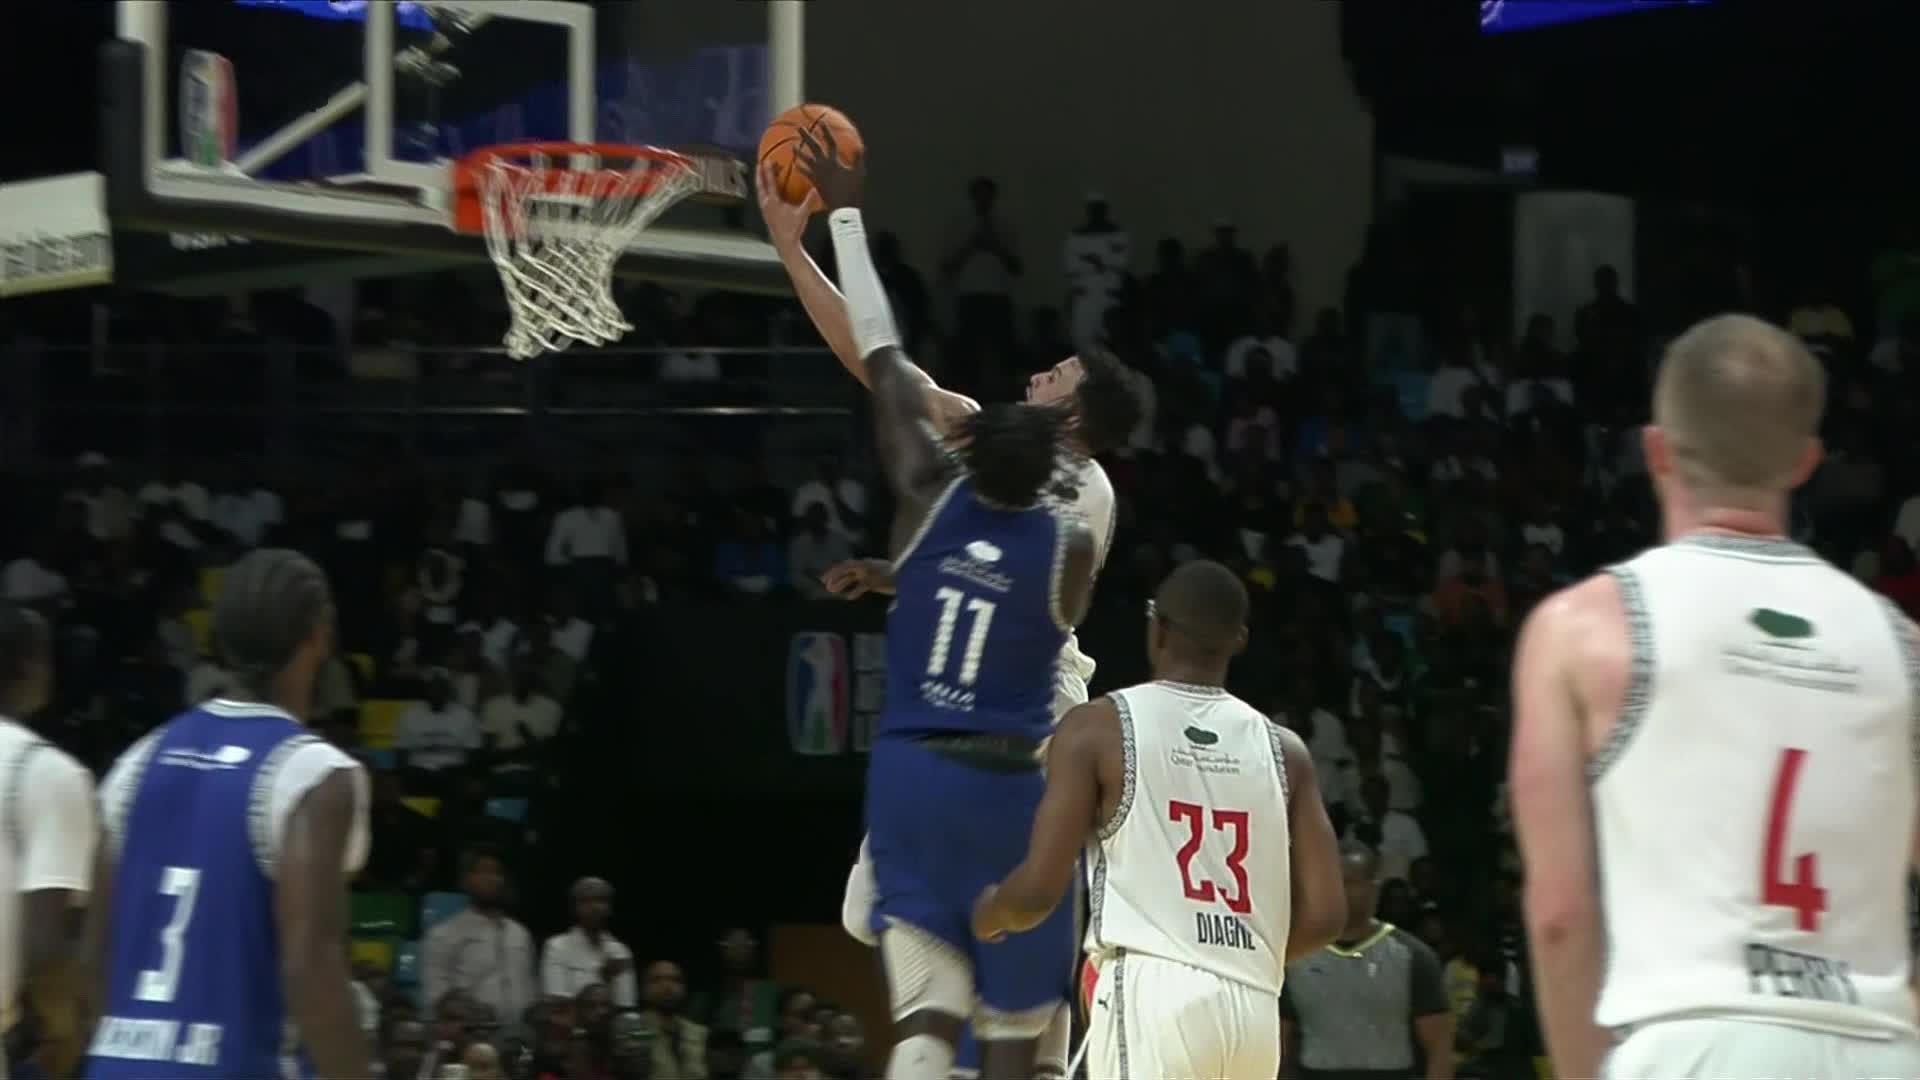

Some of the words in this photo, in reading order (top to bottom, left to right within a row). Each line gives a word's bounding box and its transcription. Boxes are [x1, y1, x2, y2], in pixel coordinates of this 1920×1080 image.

[926, 585, 997, 687] 11
[1168, 800, 1251, 914] 23
[1763, 747, 1826, 931] 4
[132, 866, 203, 1003] 3
[1196, 911, 1256, 951] DIAGNE
